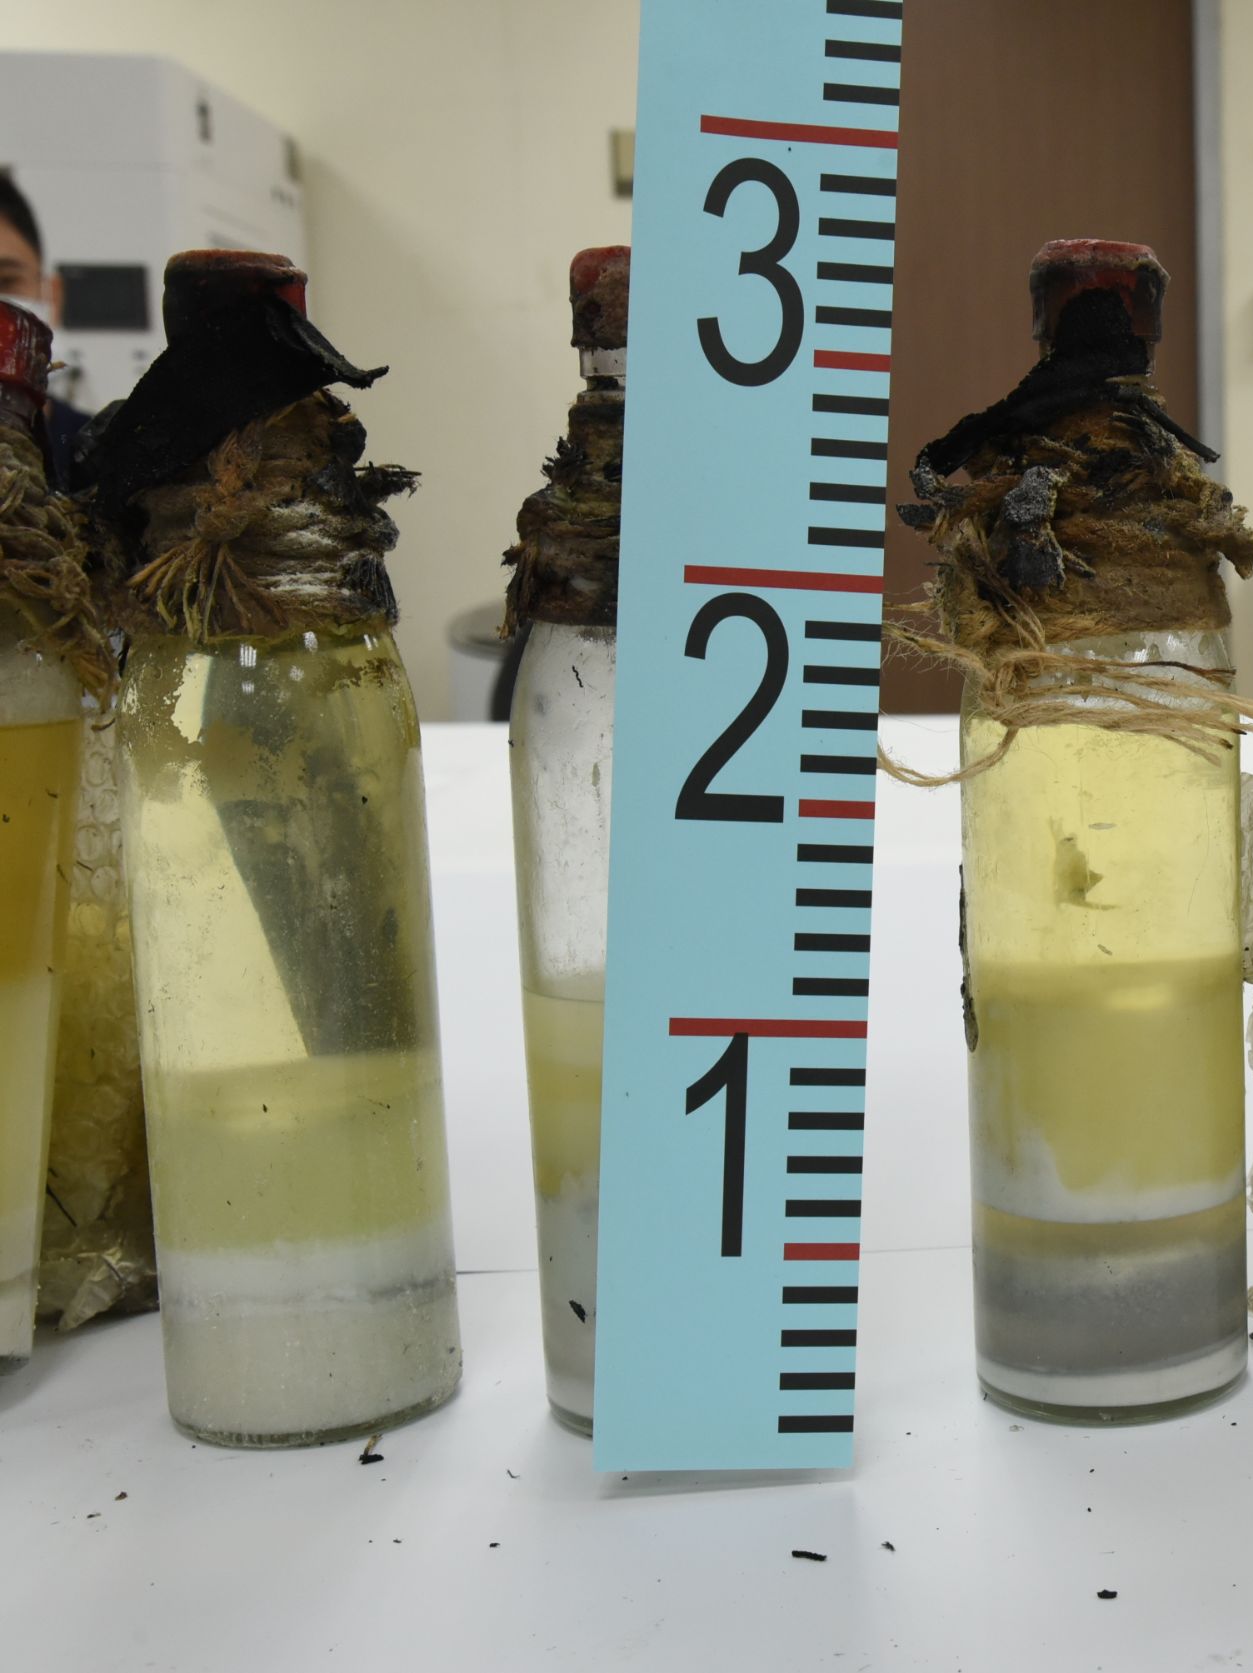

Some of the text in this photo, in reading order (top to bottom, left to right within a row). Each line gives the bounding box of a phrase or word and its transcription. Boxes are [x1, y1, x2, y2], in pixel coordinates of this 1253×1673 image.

[697, 158, 804, 387] 3
[675, 593, 789, 823] 2
[686, 1031, 749, 1257] 1
